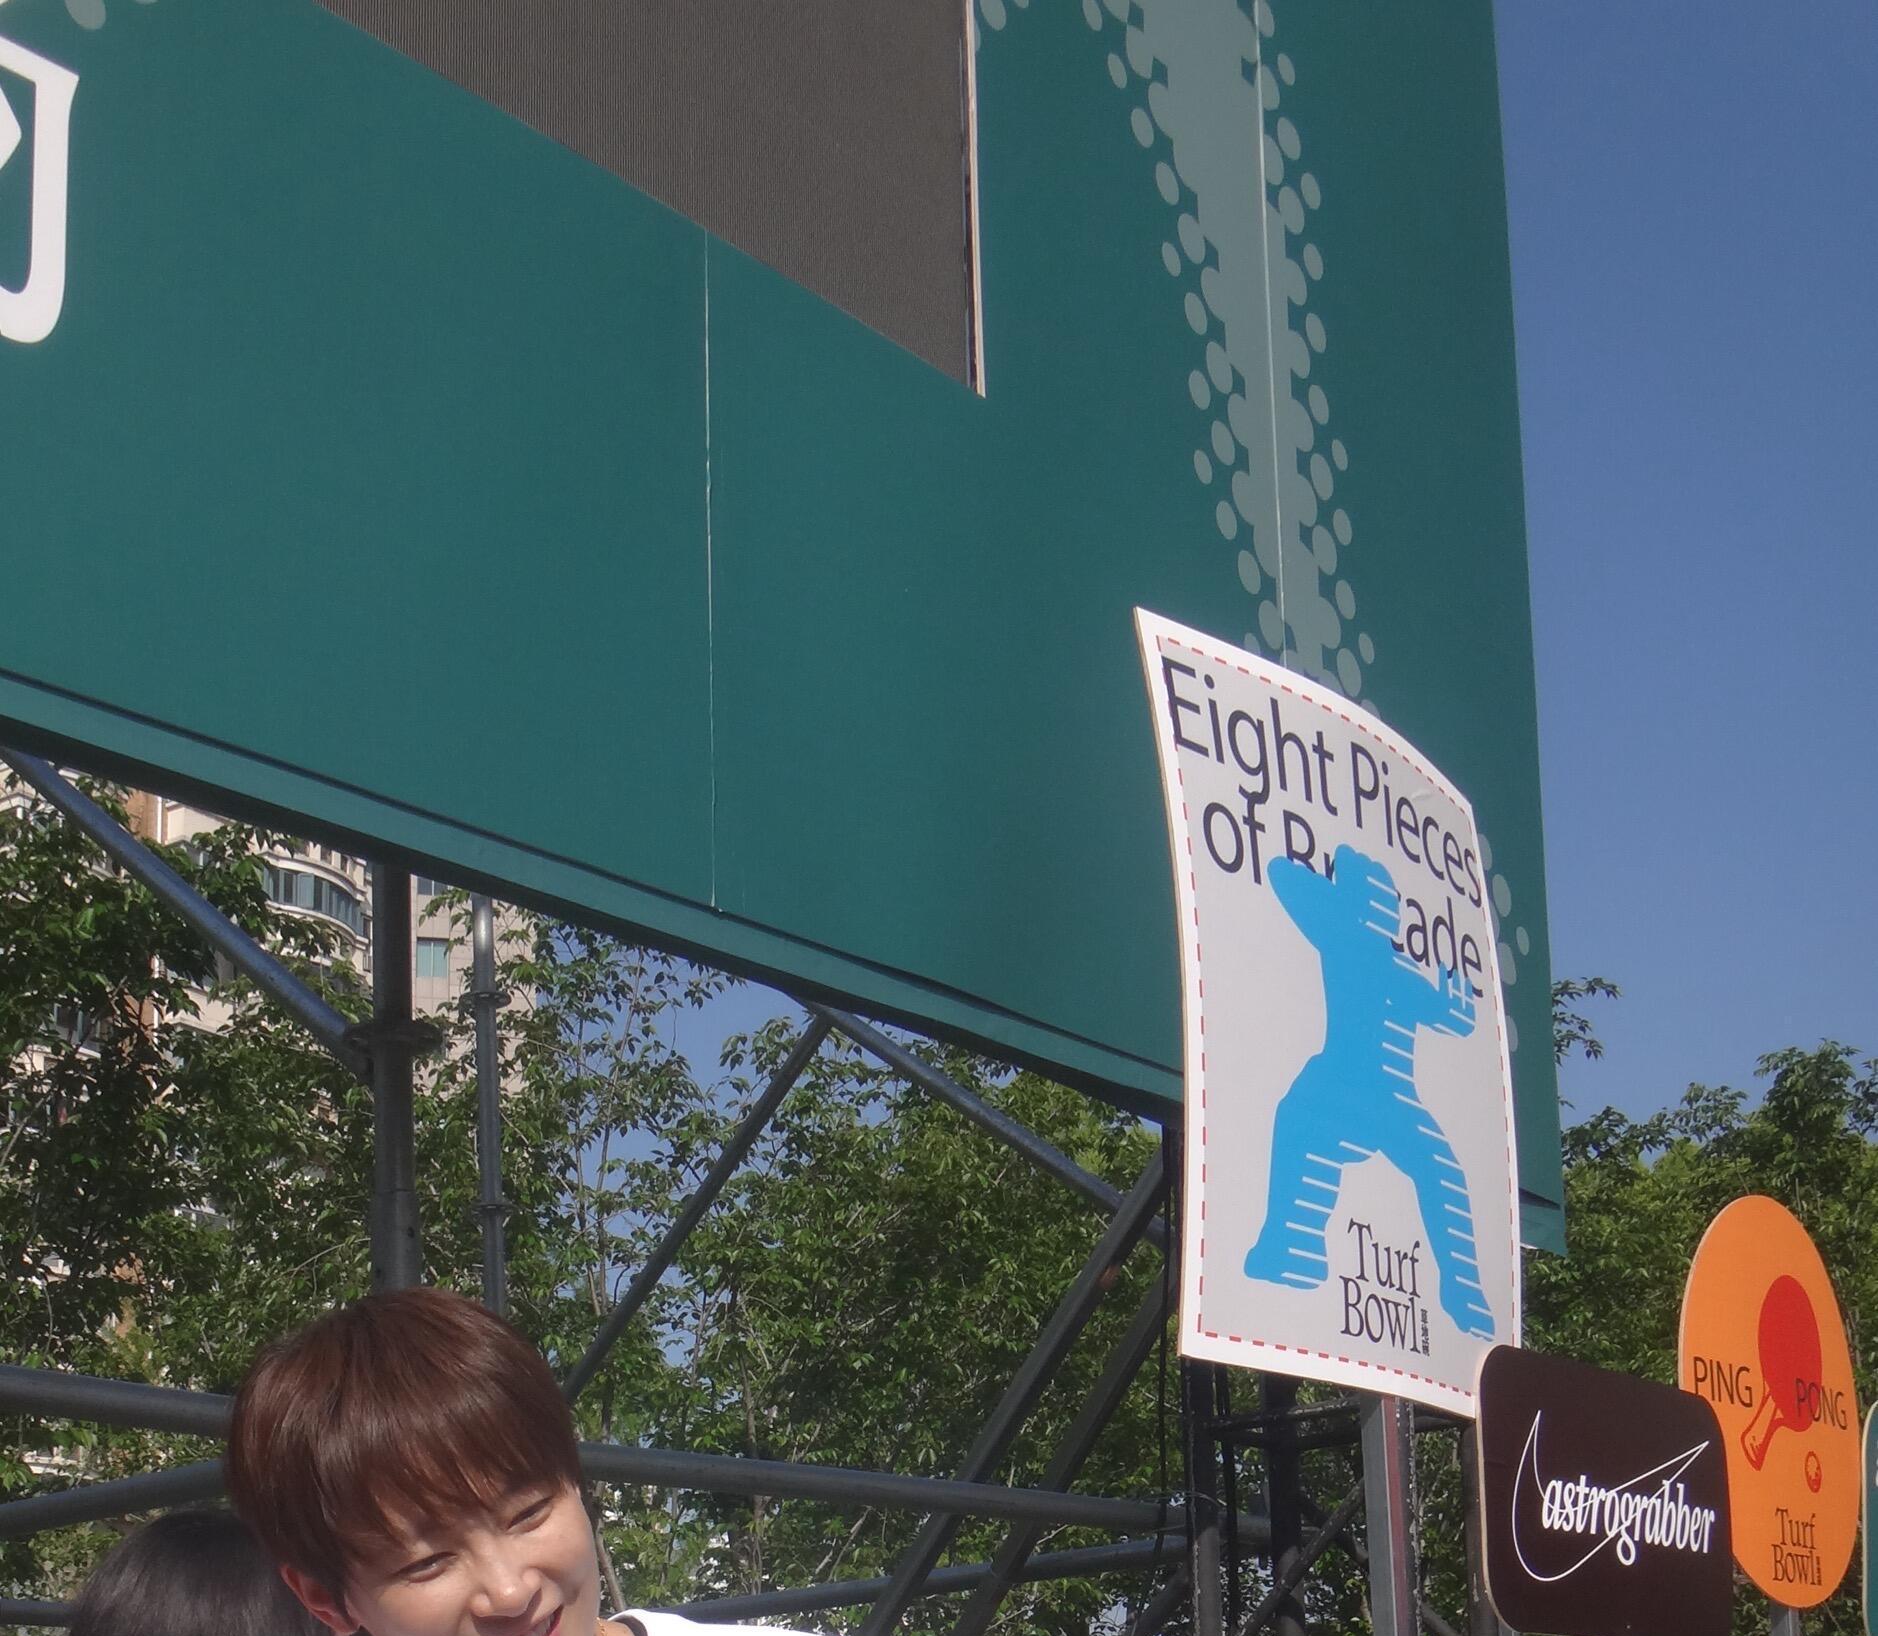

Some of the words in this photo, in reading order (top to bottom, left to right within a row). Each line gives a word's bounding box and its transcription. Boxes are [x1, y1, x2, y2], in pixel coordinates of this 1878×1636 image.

[1162, 656, 1338, 817] Eight
[1351, 741, 1482, 908] Pieces
[1203, 798, 1266, 885] of
[1283, 810, 1483, 998] Bade
[1347, 1218, 1421, 1298] Turf
[1339, 1275, 1421, 1354] Bowl
[1693, 1356, 1753, 1408] PING
[1795, 1378, 1848, 1431] PONG
[1541, 1475, 1716, 1566] astrograbber
[1775, 1507, 1817, 1550] Turf
[1771, 1544, 1817, 1586] Bowl
